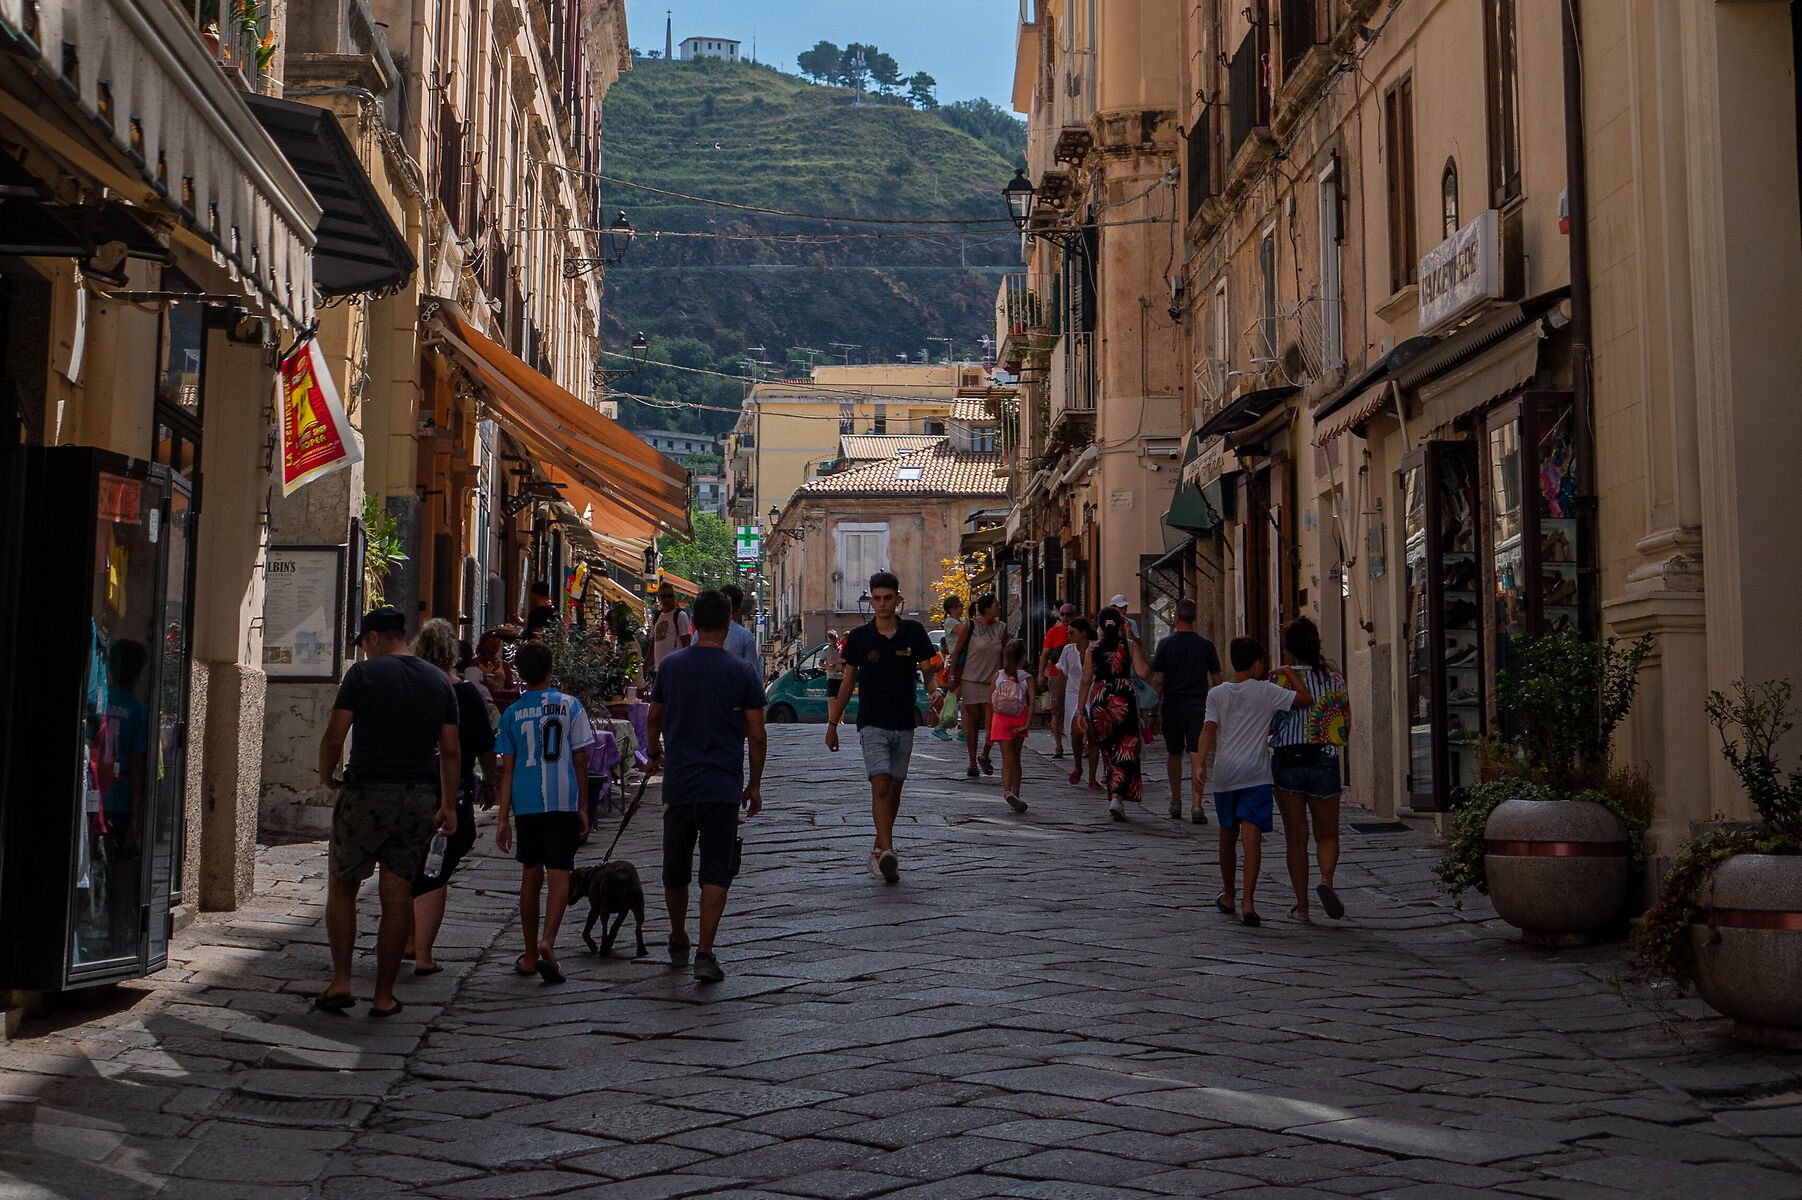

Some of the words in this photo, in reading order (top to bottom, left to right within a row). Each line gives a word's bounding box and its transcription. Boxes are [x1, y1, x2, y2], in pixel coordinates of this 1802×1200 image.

[267, 559, 297, 573] LBIN'S
[514, 703, 567, 721] MARADONA
[520, 717, 563, 768] 10
